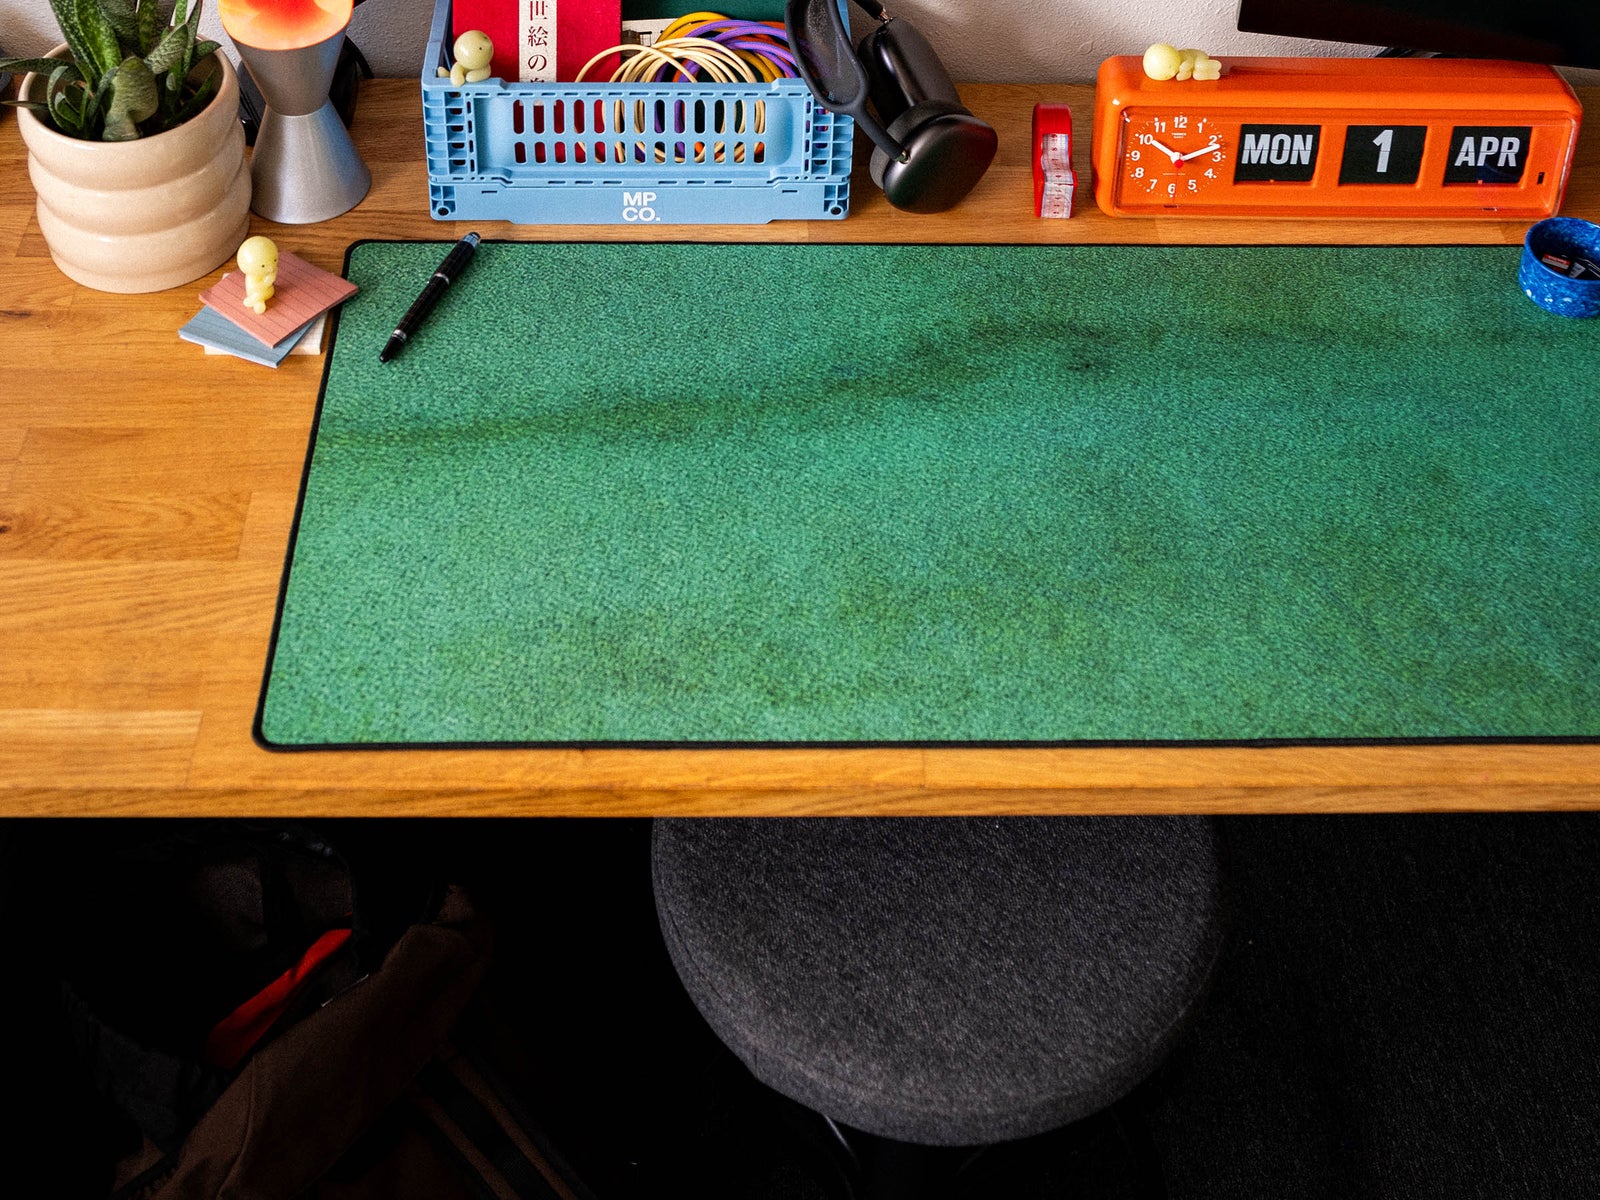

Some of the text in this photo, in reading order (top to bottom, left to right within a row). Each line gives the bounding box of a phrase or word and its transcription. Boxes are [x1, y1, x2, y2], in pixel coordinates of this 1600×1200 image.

[1154, 121, 1166, 133] 11
[1173, 116, 1188, 129] 12
[1197, 122, 1203, 134] 1
[1138, 133, 1153, 145] 10
[1208, 135, 1218, 146] 2
[1130, 150, 1141, 161] 9
[1211, 151, 1221, 162] 3
[1241, 129, 1520, 173] MON 1 APR
[1134, 167, 1144, 178] 8
[1203, 168, 1214, 179] 4
[1149, 178, 1158, 190] 7
[1167, 183, 1176, 194] 6
[1187, 179, 1197, 190] 5
[623, 191, 657, 206] MP
[622, 206, 661, 222] CO.
